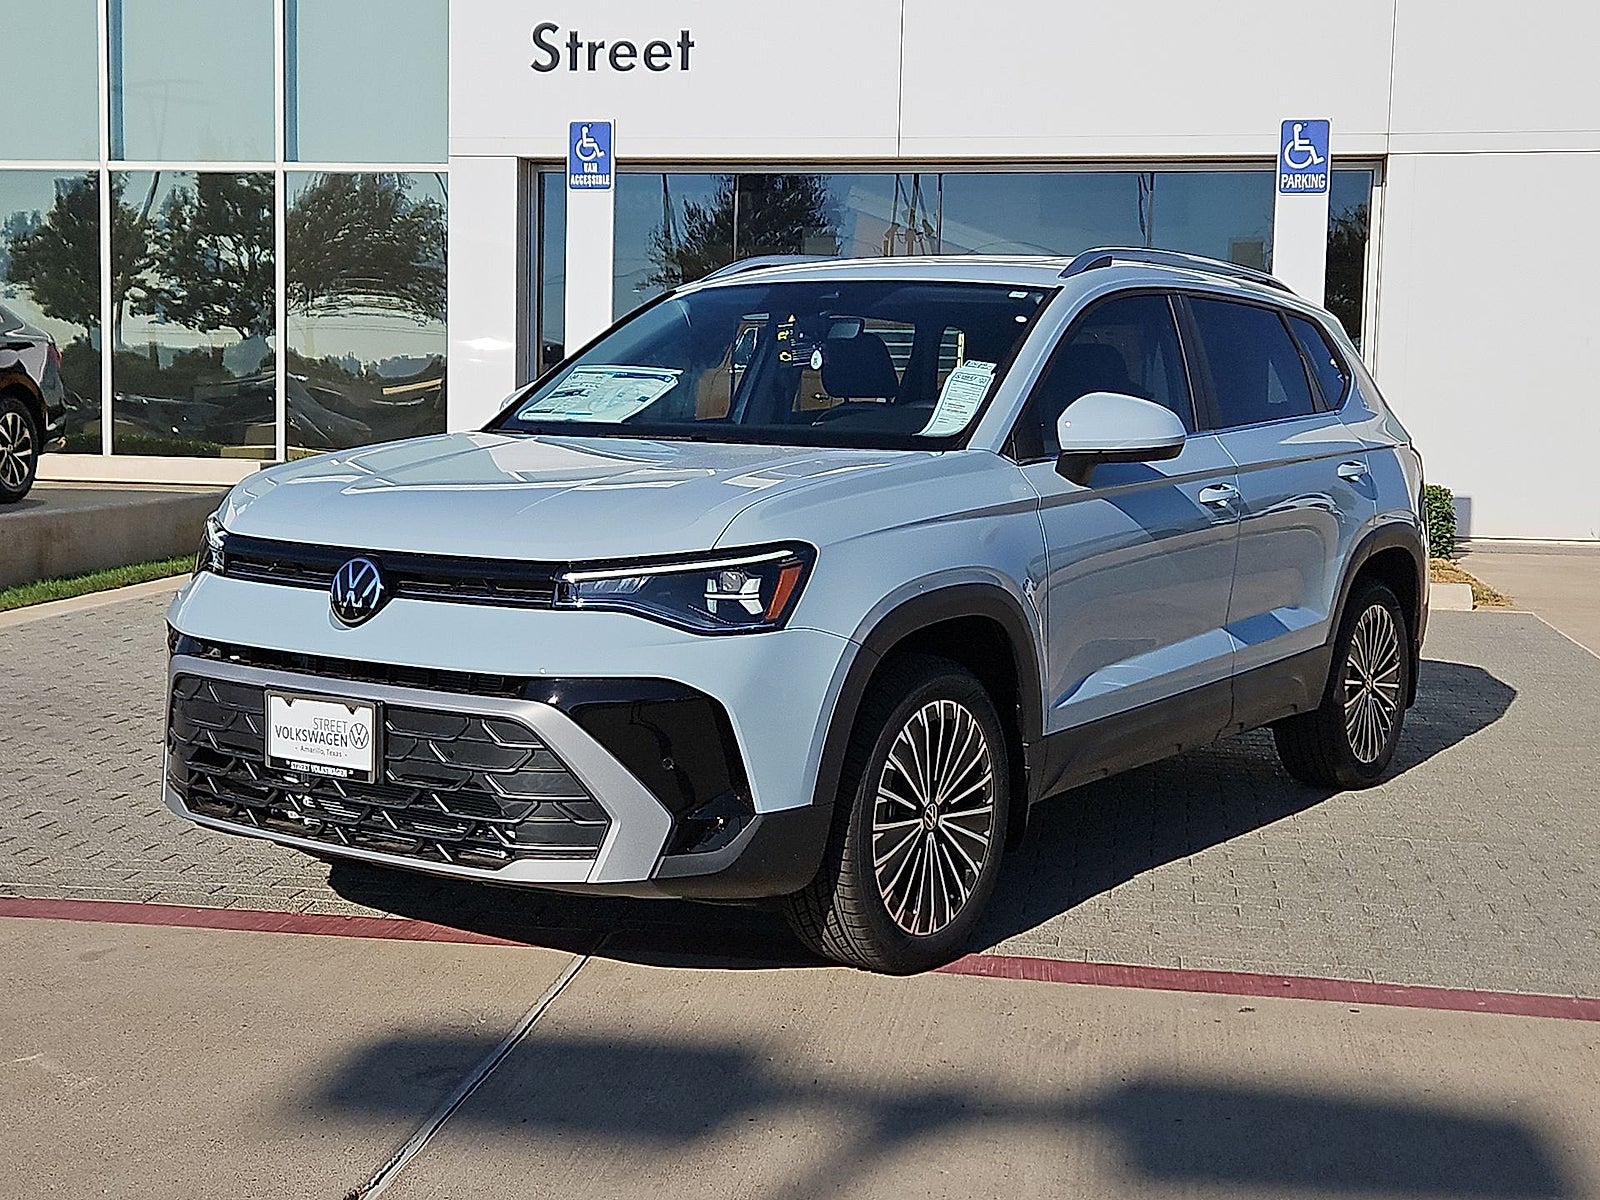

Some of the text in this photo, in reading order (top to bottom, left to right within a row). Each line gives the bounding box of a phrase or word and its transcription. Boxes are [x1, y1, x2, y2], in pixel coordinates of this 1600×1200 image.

[530, 22, 695, 73] Street
[570, 174, 610, 187] ACCESSIBLE
[1281, 173, 1326, 189] PARKING
[313, 717, 348, 734] STREET
[274, 724, 348, 748] VOLKSWAGEN
[300, 745, 325, 757] Amaro,
